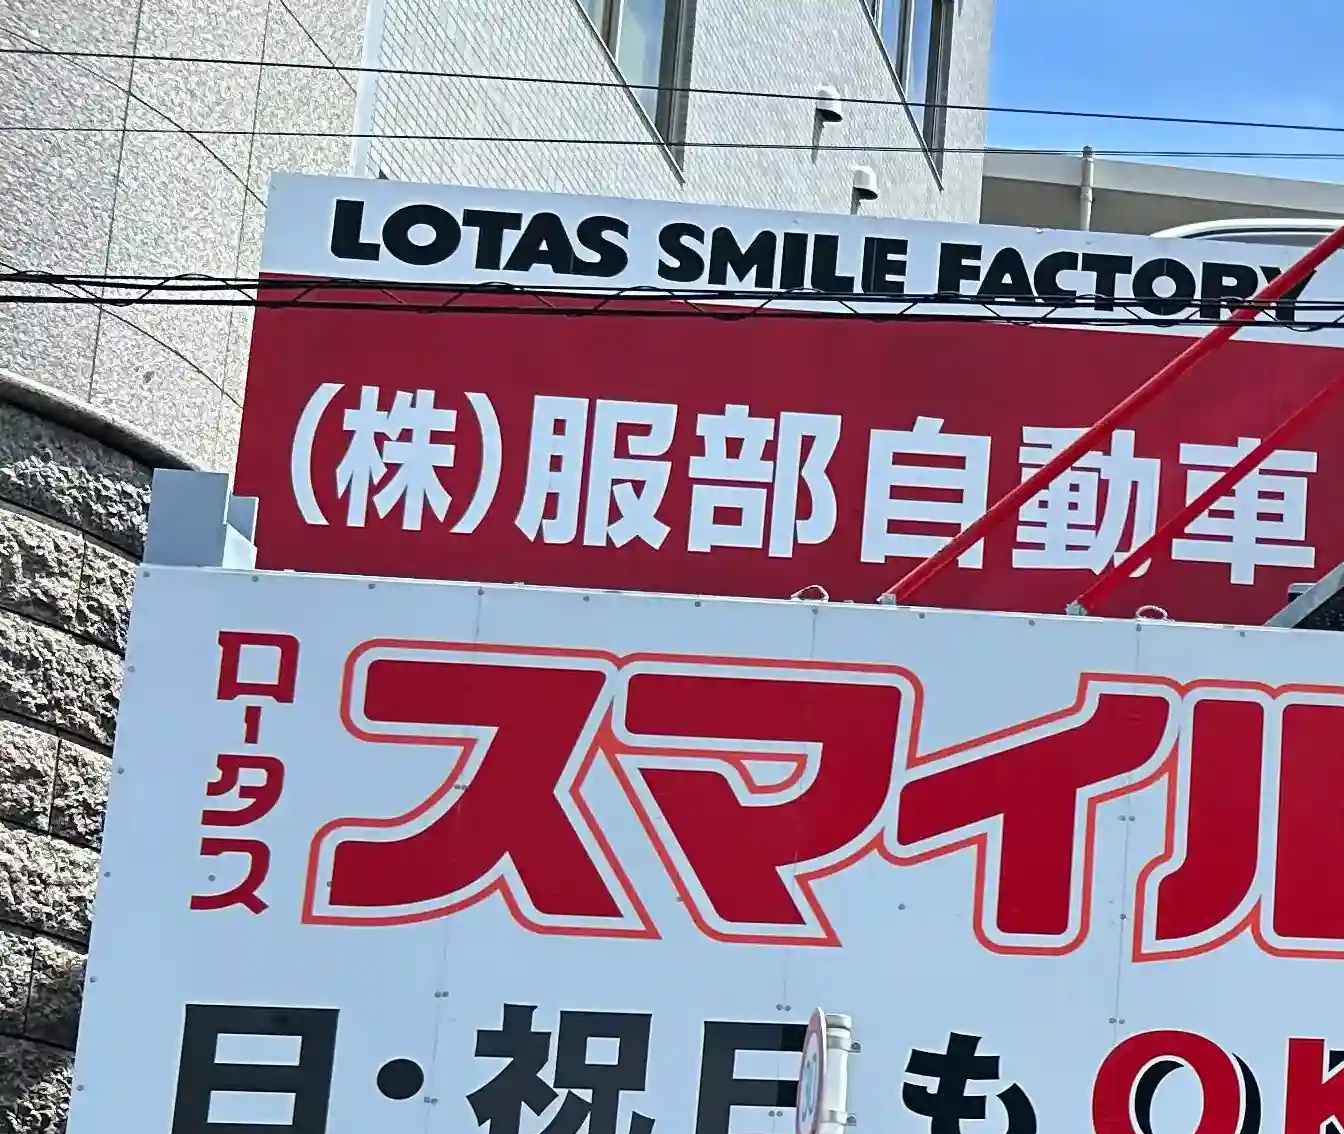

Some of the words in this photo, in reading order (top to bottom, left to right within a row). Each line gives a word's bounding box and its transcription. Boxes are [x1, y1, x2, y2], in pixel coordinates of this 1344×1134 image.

[330, 199, 629, 277] LOTAS
[657, 222, 908, 294] SMILE
[938, 242, 1317, 322] FACTORY
[290, 382, 1317, 586] (株)服部自動車
[191, 630, 300, 915] ロータス
